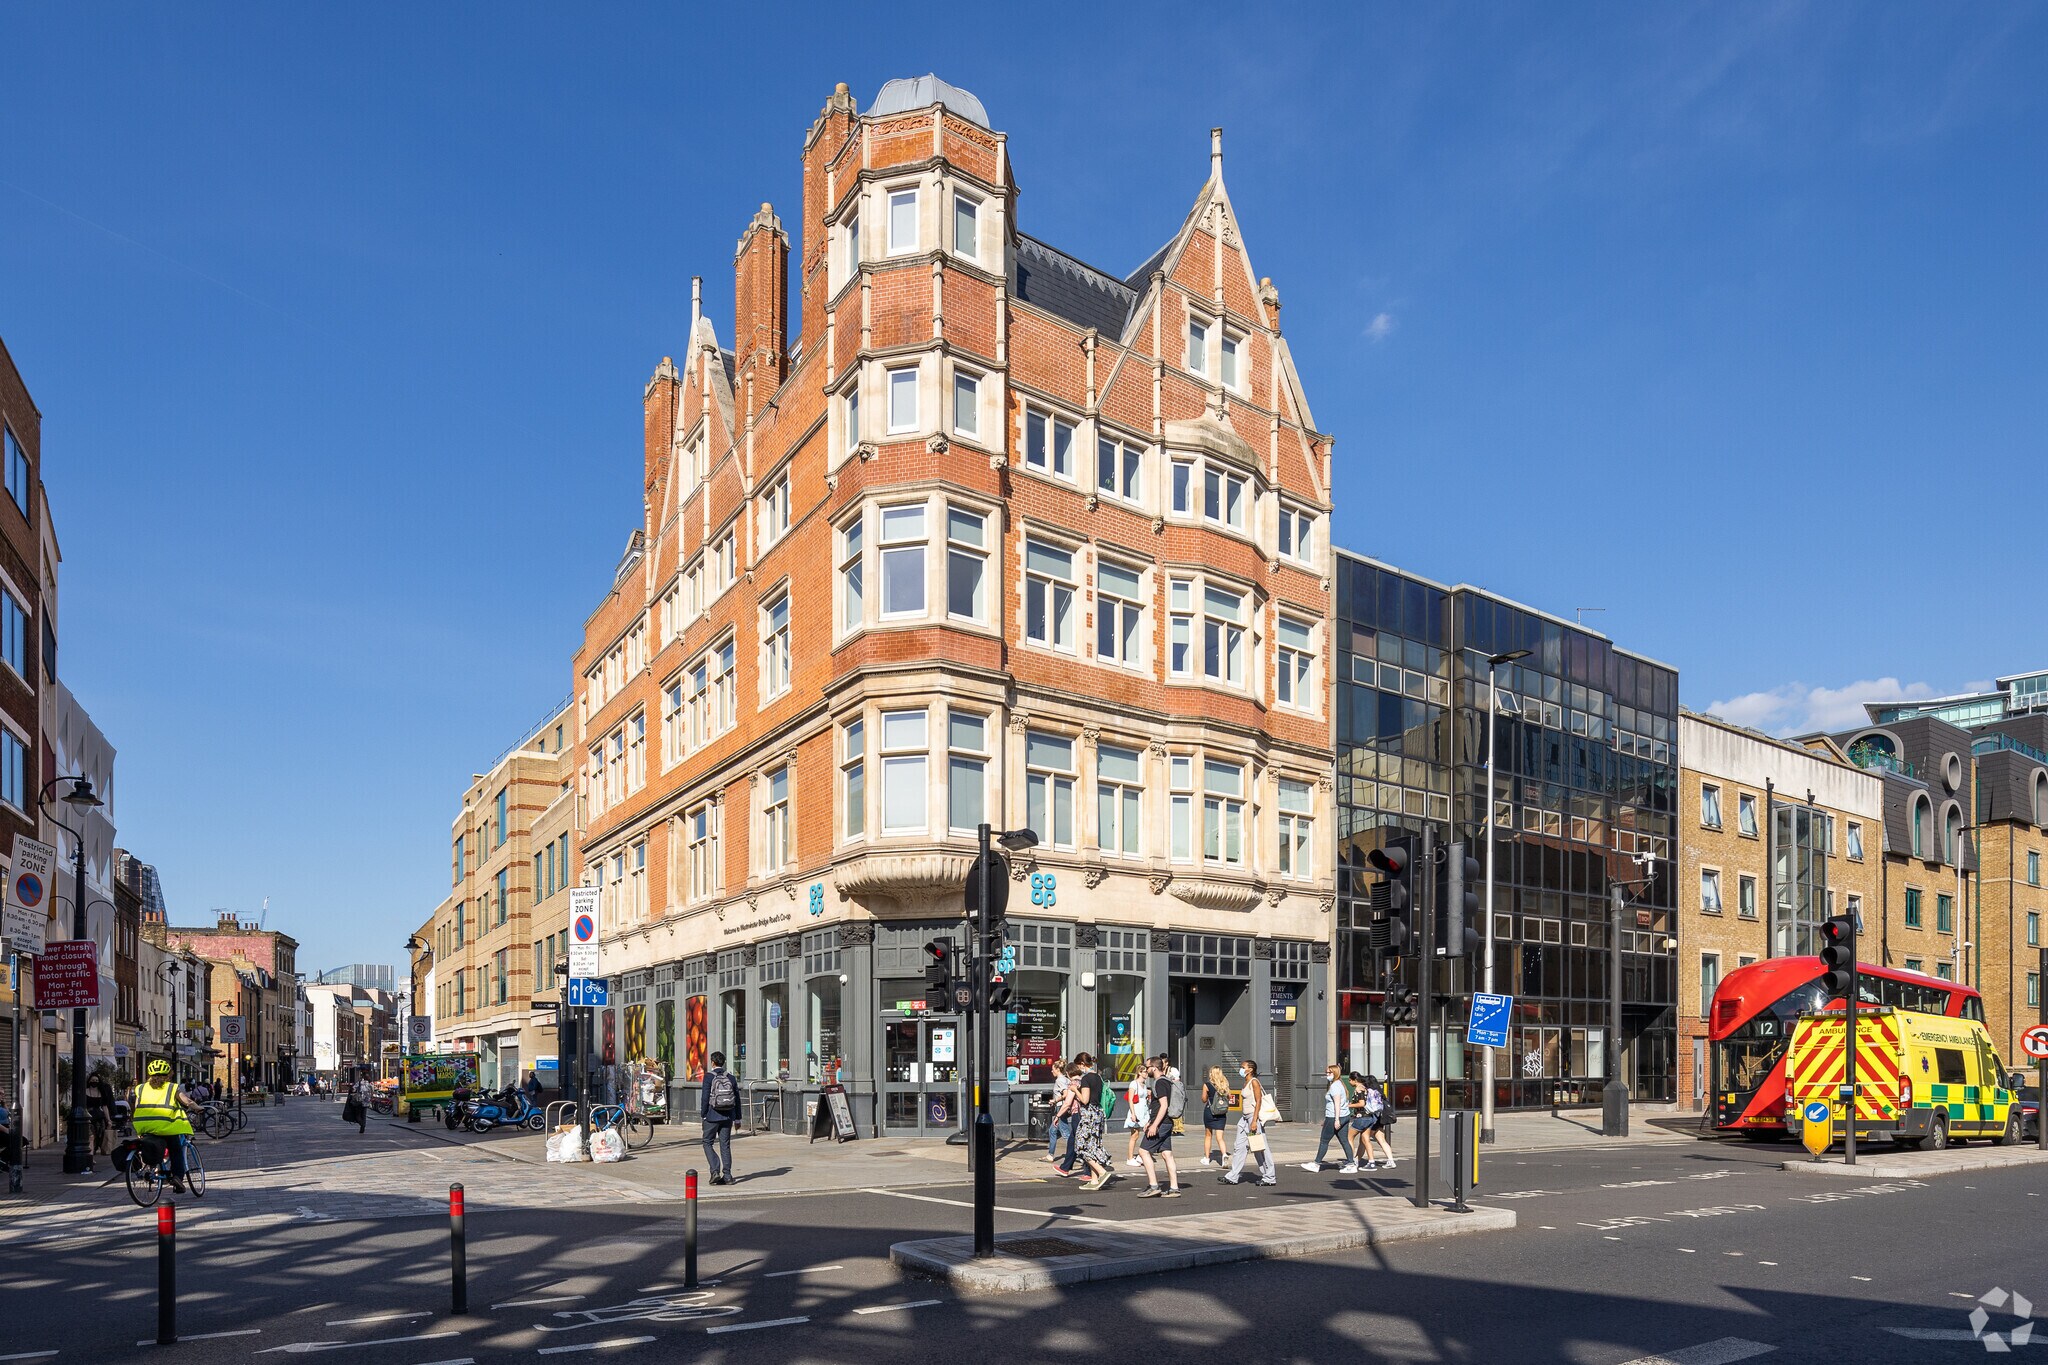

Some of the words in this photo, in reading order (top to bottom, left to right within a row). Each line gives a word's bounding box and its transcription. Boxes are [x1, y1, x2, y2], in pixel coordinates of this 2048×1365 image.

[18, 838, 53, 857] Restricted
[22, 850, 47, 864] parking
[20, 858, 46, 875] ZONE
[63, 943, 90, 951] Marsh
[37, 954, 59, 962] timed
[55, 961, 88, 971] through
[39, 972, 63, 980] motor
[65, 970, 91, 978] traffic
[71, 980, 82, 988] Fri
[75, 989, 88, 997] pm
[37, 998, 56, 1006] 4.45
[1760, 1022, 1774, 1035] 12
[1819, 1026, 1873, 1035] AMBULNCE
[1921, 1031, 1948, 1043] EMERGENCY
[1948, 1035, 1976, 1046] AMBULANCE
